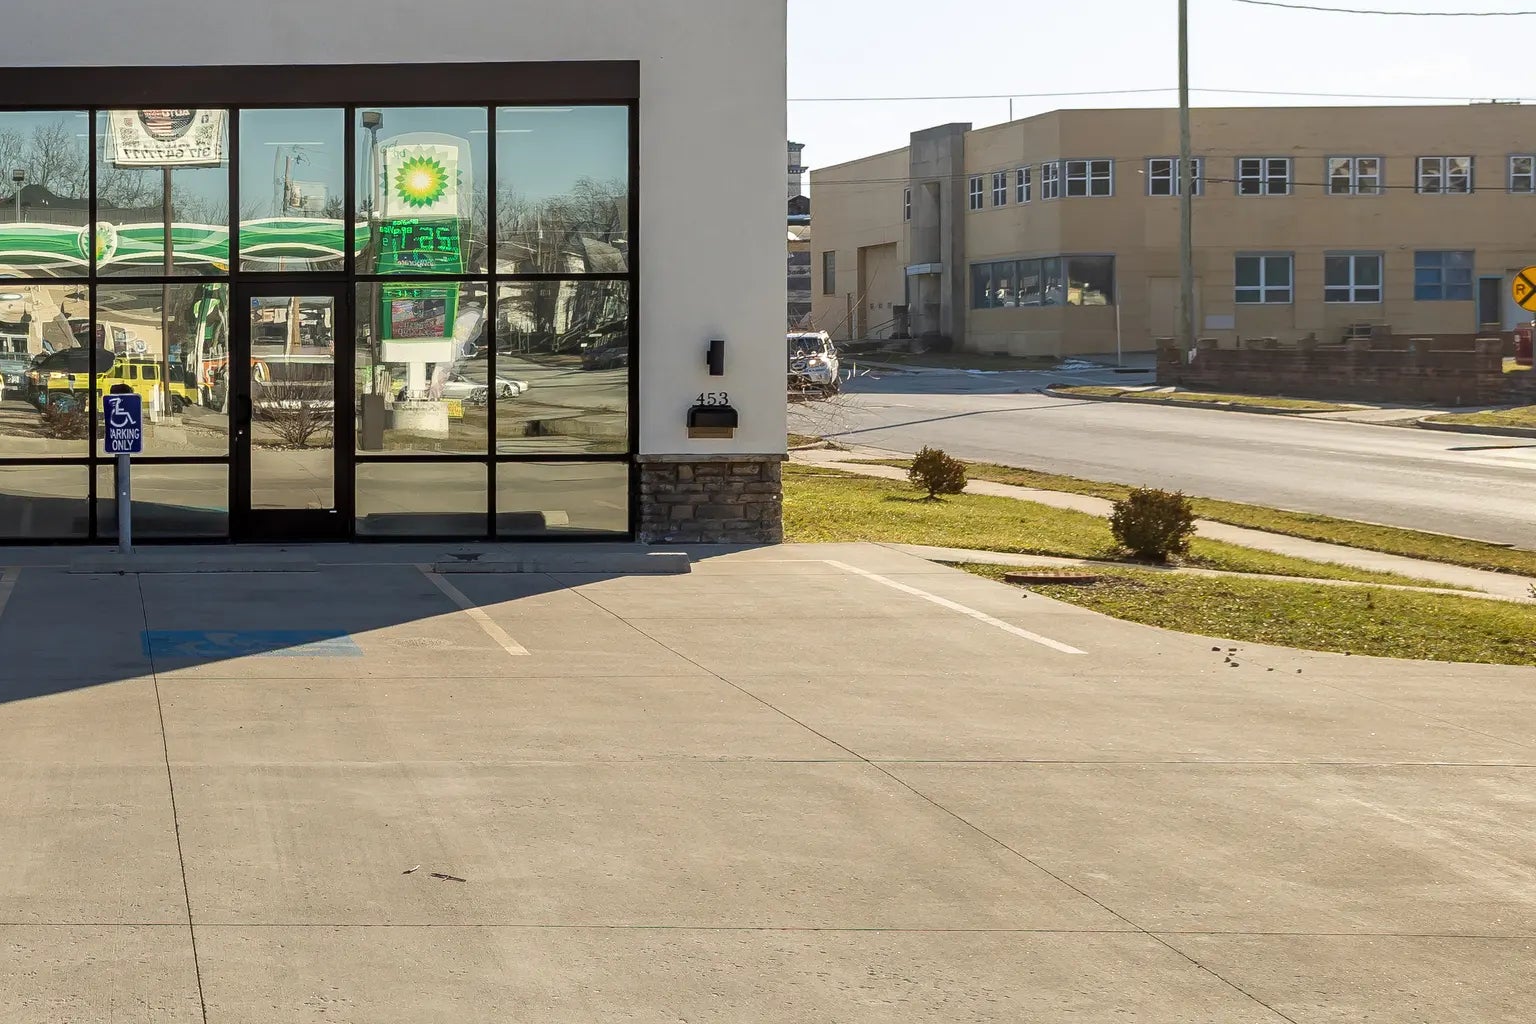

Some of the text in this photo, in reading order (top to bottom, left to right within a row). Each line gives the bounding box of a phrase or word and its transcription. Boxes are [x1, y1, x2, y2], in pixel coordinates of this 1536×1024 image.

[1515, 283, 1526, 296] R
[696, 392, 729, 405] 453
[112, 439, 134, 451] ONLY
